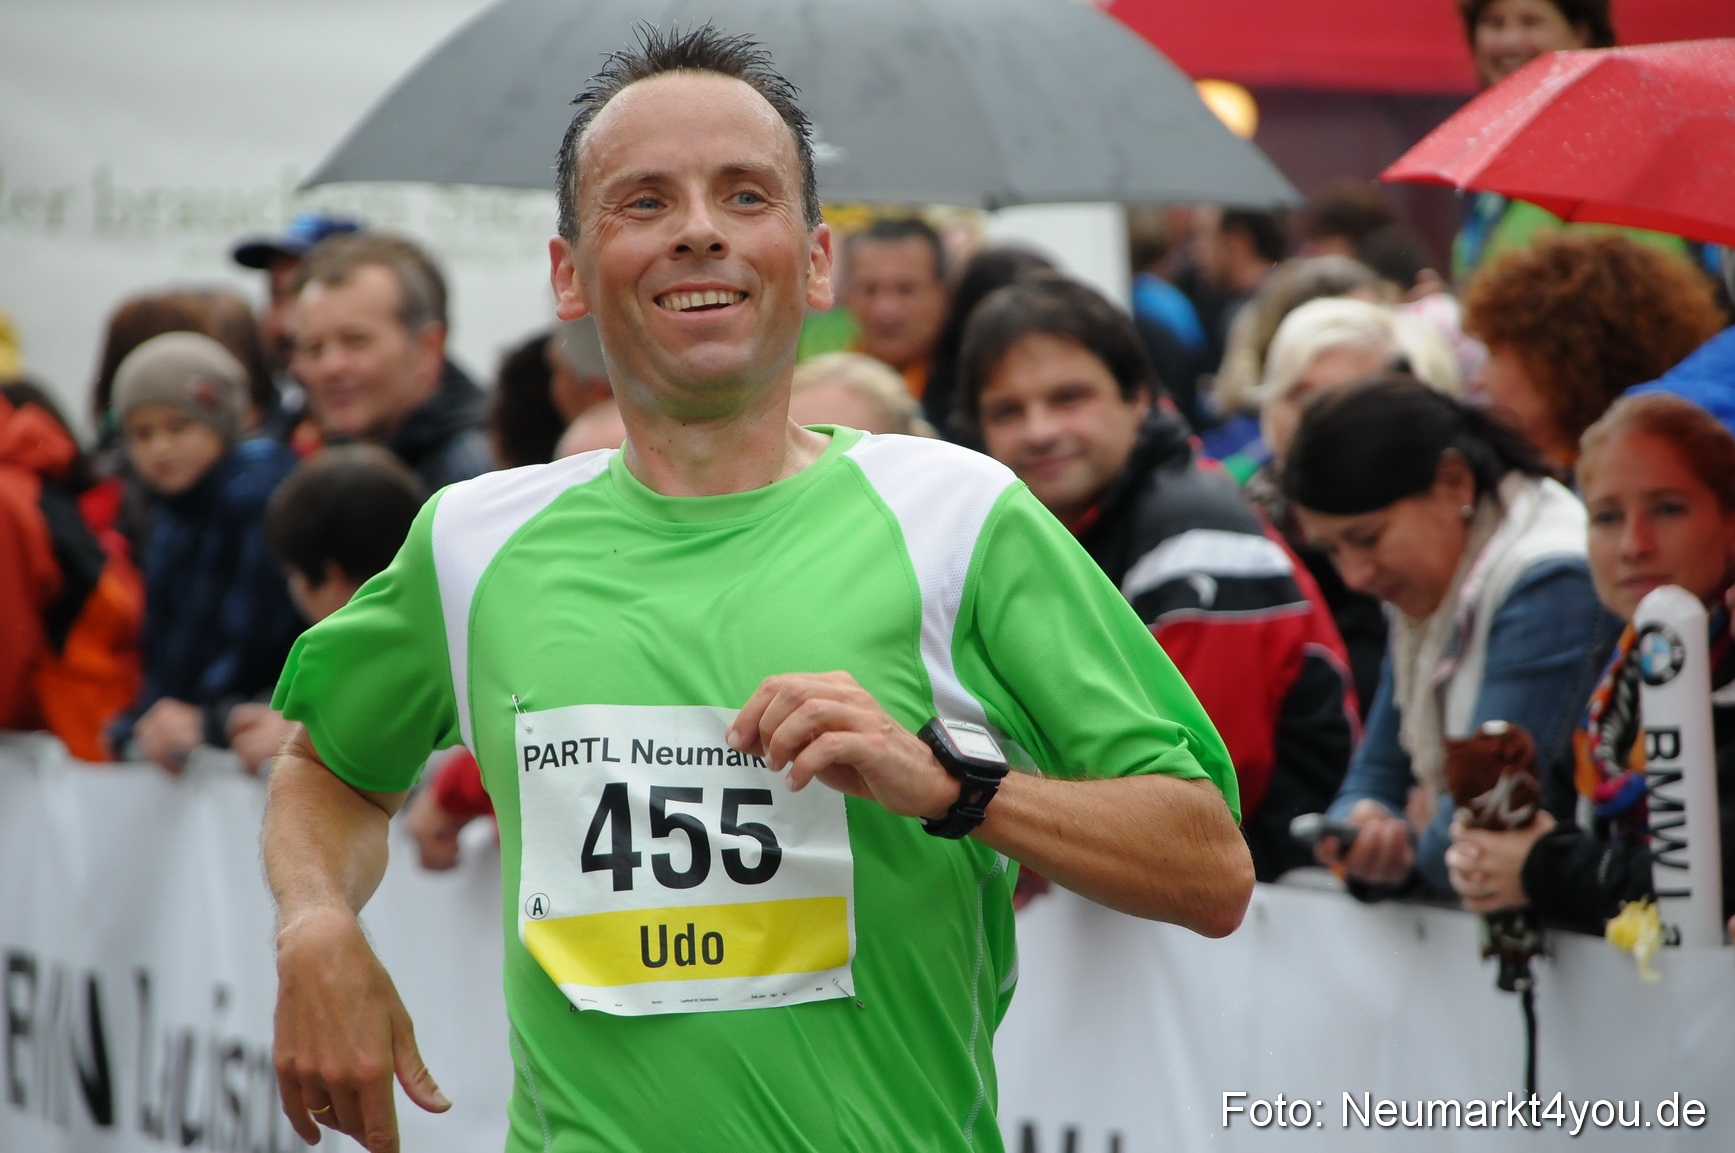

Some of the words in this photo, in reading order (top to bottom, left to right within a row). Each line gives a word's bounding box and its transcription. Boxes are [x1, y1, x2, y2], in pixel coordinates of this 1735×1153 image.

[523, 737, 621, 772] PARTL
[1646, 728, 1689, 871] BMW
[581, 782, 783, 892] 455
[532, 897, 544, 916] A
[640, 922, 725, 969] Udo
